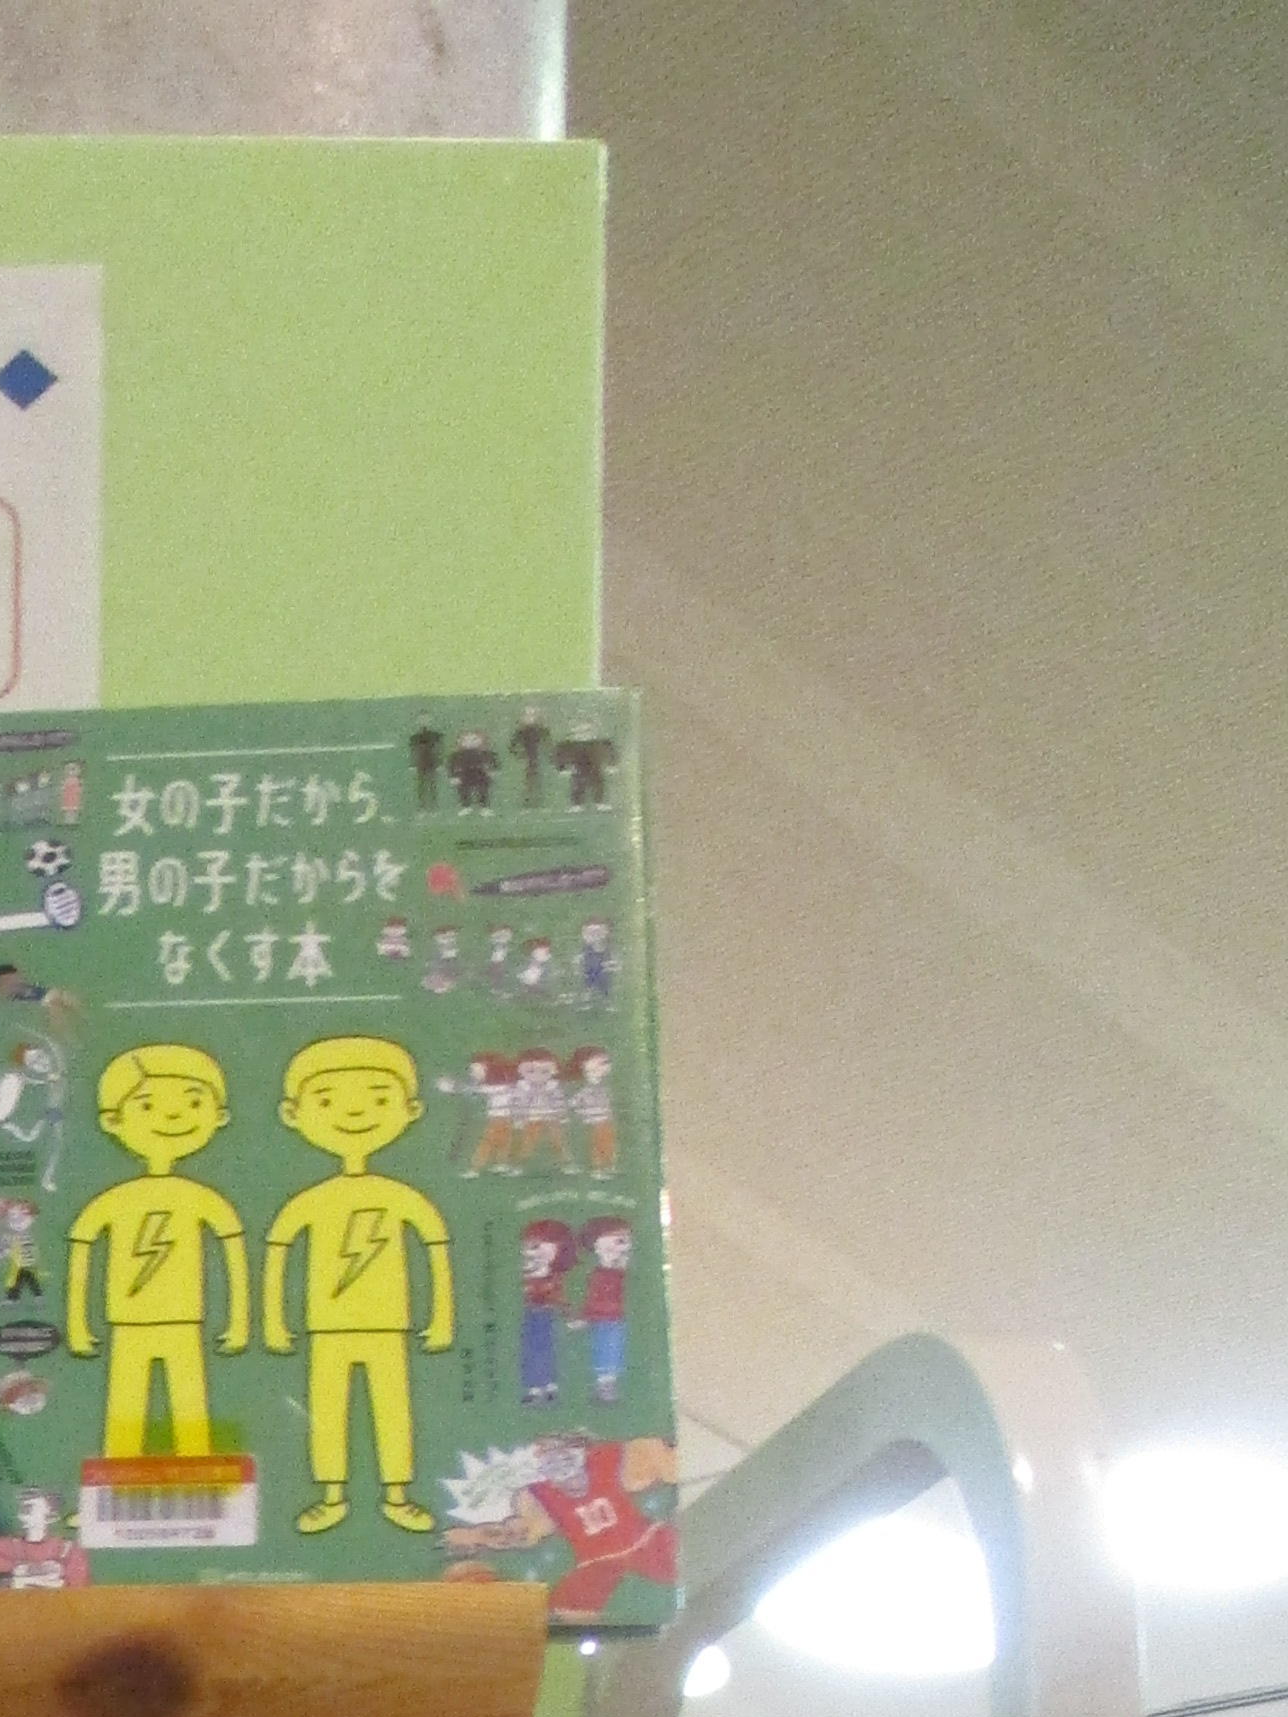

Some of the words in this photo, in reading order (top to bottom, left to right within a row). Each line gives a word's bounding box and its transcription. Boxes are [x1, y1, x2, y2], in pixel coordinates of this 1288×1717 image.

[96, 848, 409, 917] 男の子だからを
[156, 920, 338, 988] なくす本
